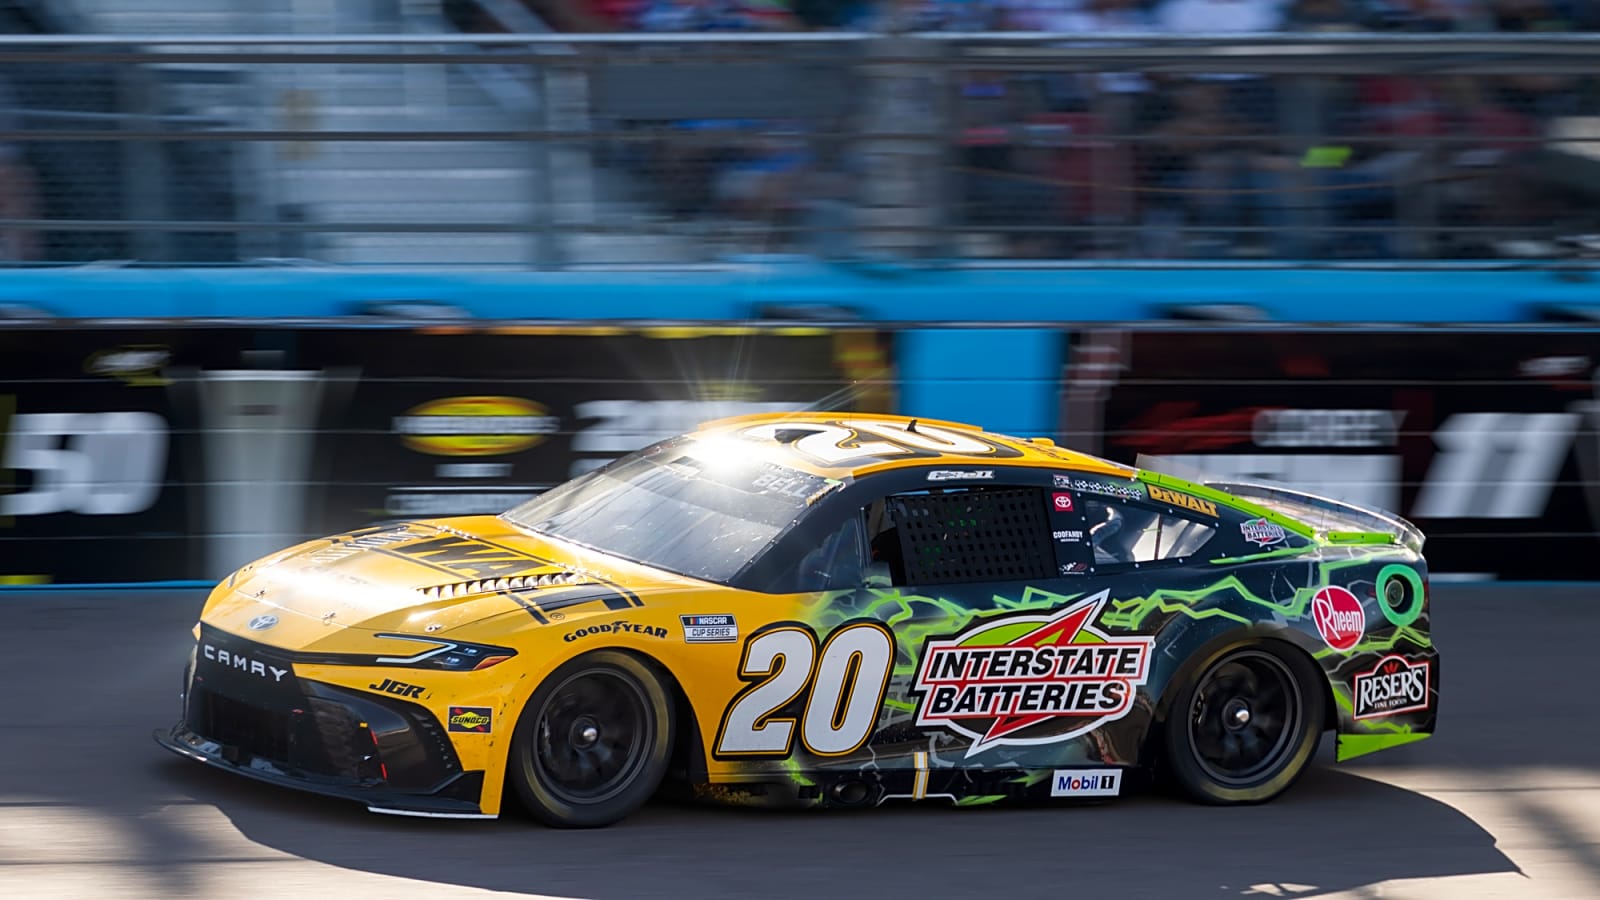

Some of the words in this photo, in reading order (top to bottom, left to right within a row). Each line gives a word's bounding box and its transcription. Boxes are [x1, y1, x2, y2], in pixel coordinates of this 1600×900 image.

[699, 616, 728, 625] NASCAR
[1315, 588, 1362, 641] Rheem
[563, 620, 668, 643] GOODYEAR
[691, 627, 706, 637] CUP
[706, 627, 731, 637] SERIES
[204, 644, 288, 682] CAMRY
[928, 646, 1141, 679] INTERSTATE
[368, 678, 426, 699] JGR
[716, 624, 893, 756] 20
[931, 681, 1129, 714] BATTERIES
[1358, 667, 1425, 714] RESER'S
[1374, 701, 1388, 709] FINE
[452, 716, 489, 724] SUNOCO
[1057, 775, 1099, 791] Mobil
[1101, 775, 1115, 790] 1
